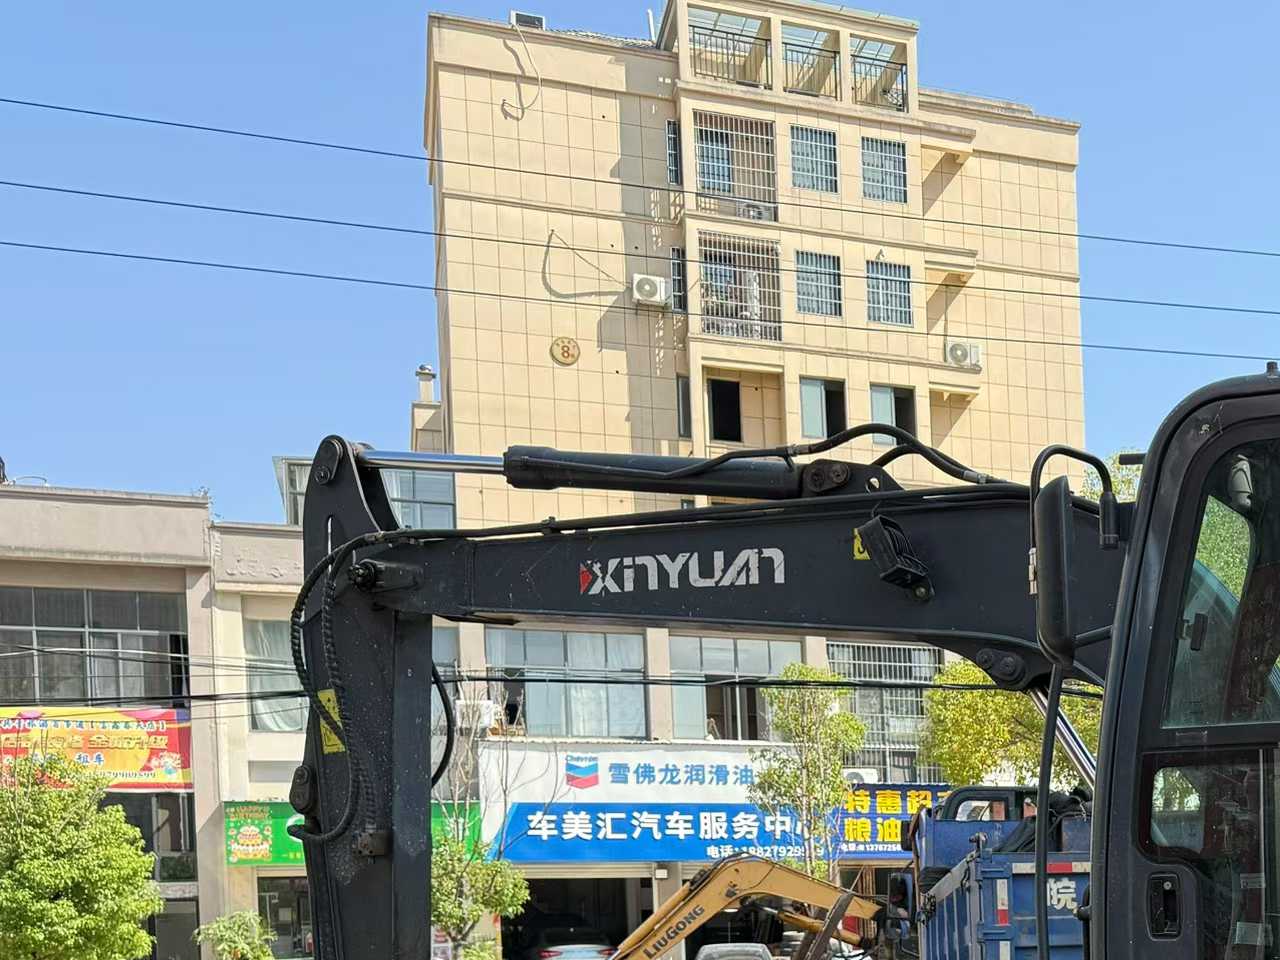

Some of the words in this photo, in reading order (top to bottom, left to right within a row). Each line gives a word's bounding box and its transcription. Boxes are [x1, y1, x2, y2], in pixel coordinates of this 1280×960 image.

[561, 345, 570, 358] 8
[609, 763, 755, 785] 雪佛龙润滑油
[844, 790, 952, 815] 特惠超
[844, 817, 901, 842] 粮油
[643, 905, 705, 959] LIUGONG
